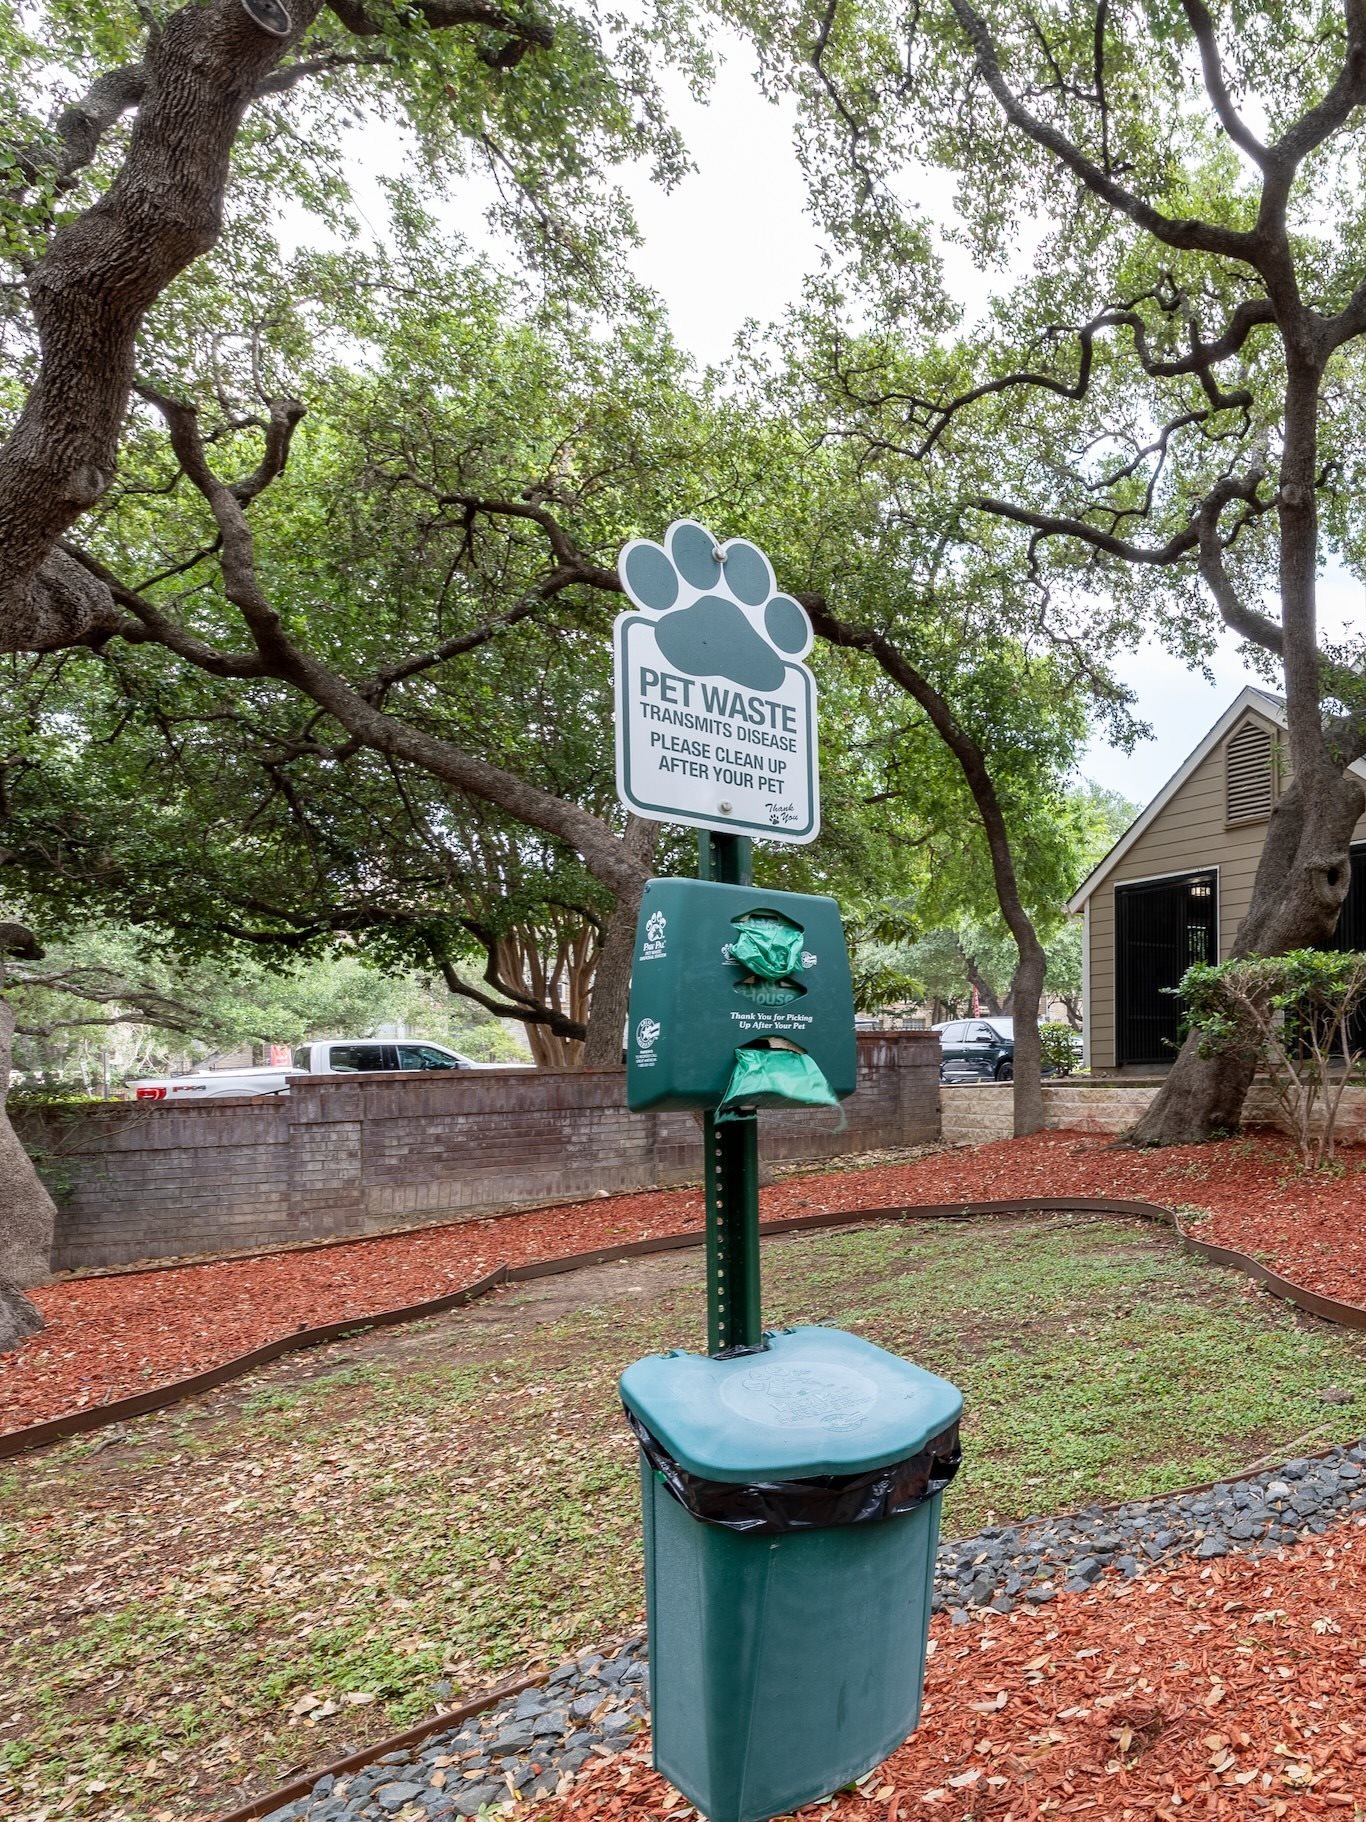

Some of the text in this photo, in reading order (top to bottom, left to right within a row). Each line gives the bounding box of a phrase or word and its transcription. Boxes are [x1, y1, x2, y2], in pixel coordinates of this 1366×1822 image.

[640, 666, 797, 734] PET WASTE
[640, 701, 797, 753] TRANSMITS DISEASE
[651, 731, 787, 775] PLEASE CLEAN UP
[658, 755, 785, 794] AFTER YOUR PET
[765, 803, 795, 813] Thank
[780, 812, 799, 824] You
[730, 1012, 813, 1023] Thank You for Picking
[739, 1021, 806, 1030] Up After Your Pet
